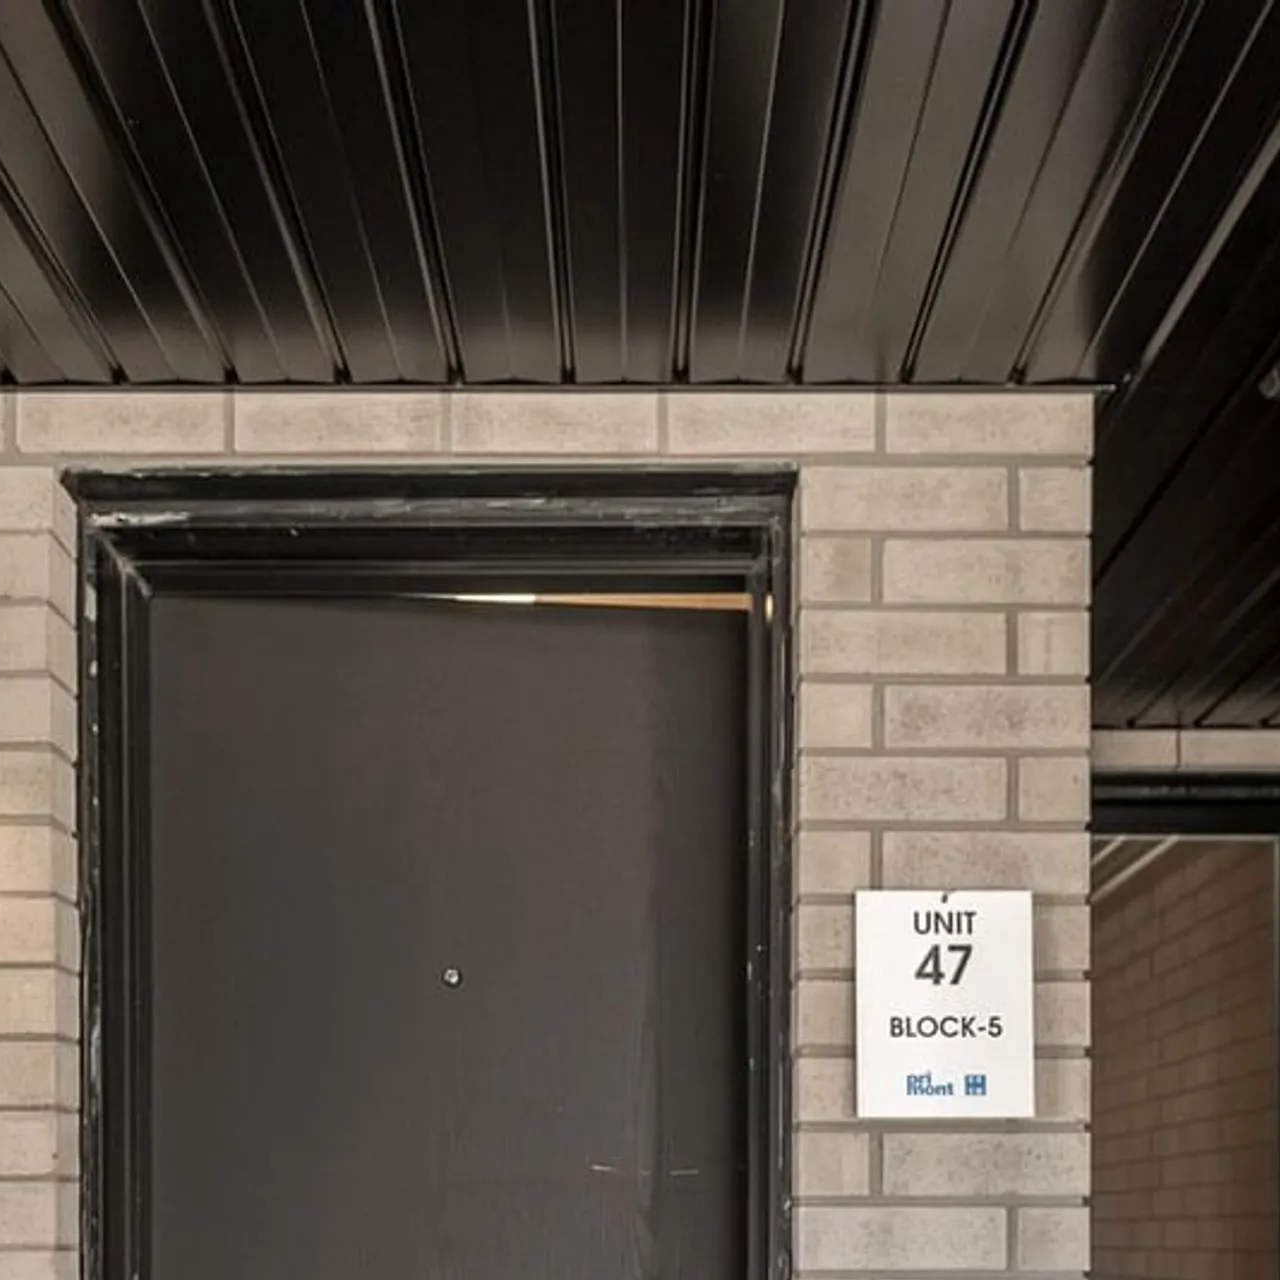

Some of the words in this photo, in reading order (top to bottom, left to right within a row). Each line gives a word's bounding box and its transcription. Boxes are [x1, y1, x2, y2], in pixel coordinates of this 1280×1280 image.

[913, 911, 977, 935] UNIT
[914, 944, 974, 986] 47
[889, 1015, 1004, 1039] BLOCK-5
